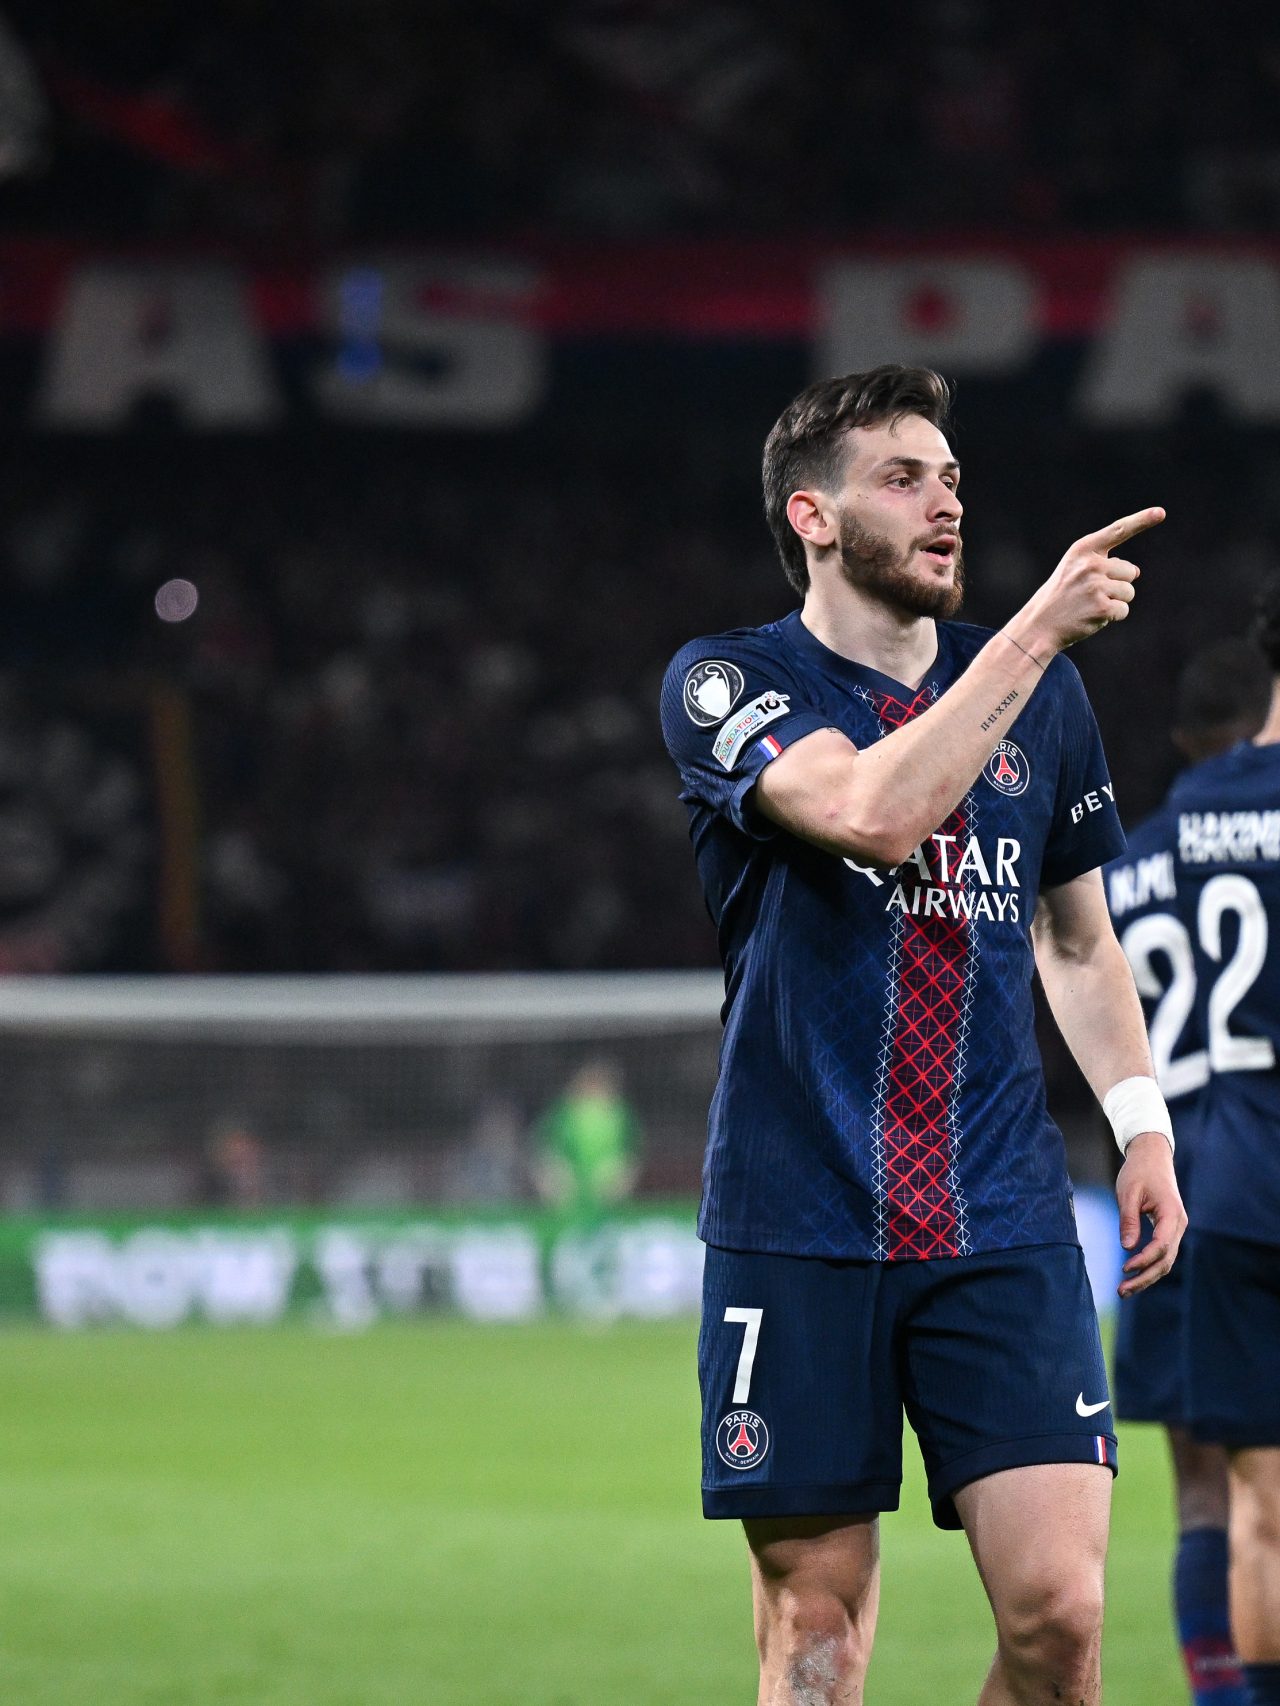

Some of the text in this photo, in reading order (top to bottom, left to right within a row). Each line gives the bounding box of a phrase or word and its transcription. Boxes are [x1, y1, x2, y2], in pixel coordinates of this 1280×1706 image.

[719, 712, 759, 761] FOUNDATION
[885, 883, 1019, 924] AIRWAYS
[1197, 873, 1276, 1073] 2
[723, 1307, 763, 1403] 7
[725, 1413, 760, 1428] PARIS
